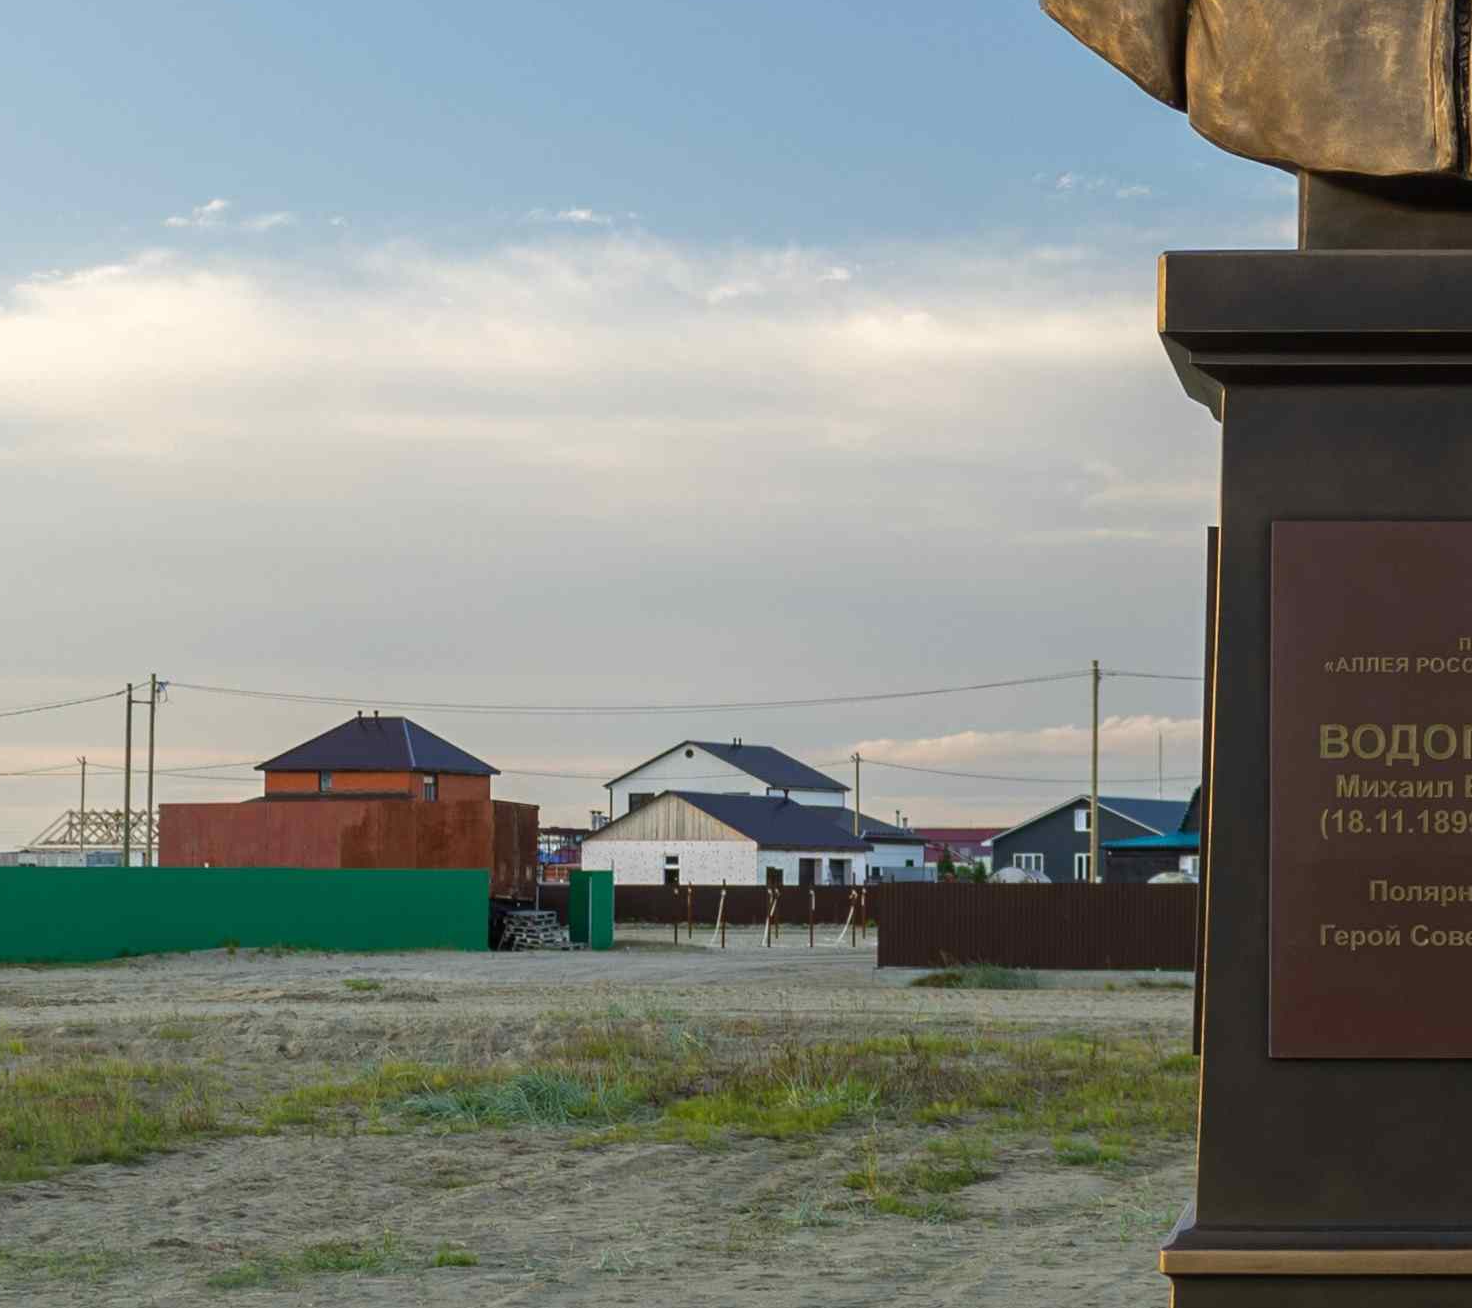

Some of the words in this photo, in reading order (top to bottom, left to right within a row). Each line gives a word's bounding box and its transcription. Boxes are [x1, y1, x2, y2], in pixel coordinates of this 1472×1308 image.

[1324, 656, 1409, 674] «АЛЛЕЯ
[1335, 774, 1454, 799] Михаил
[1319, 923, 1401, 952] Герой
